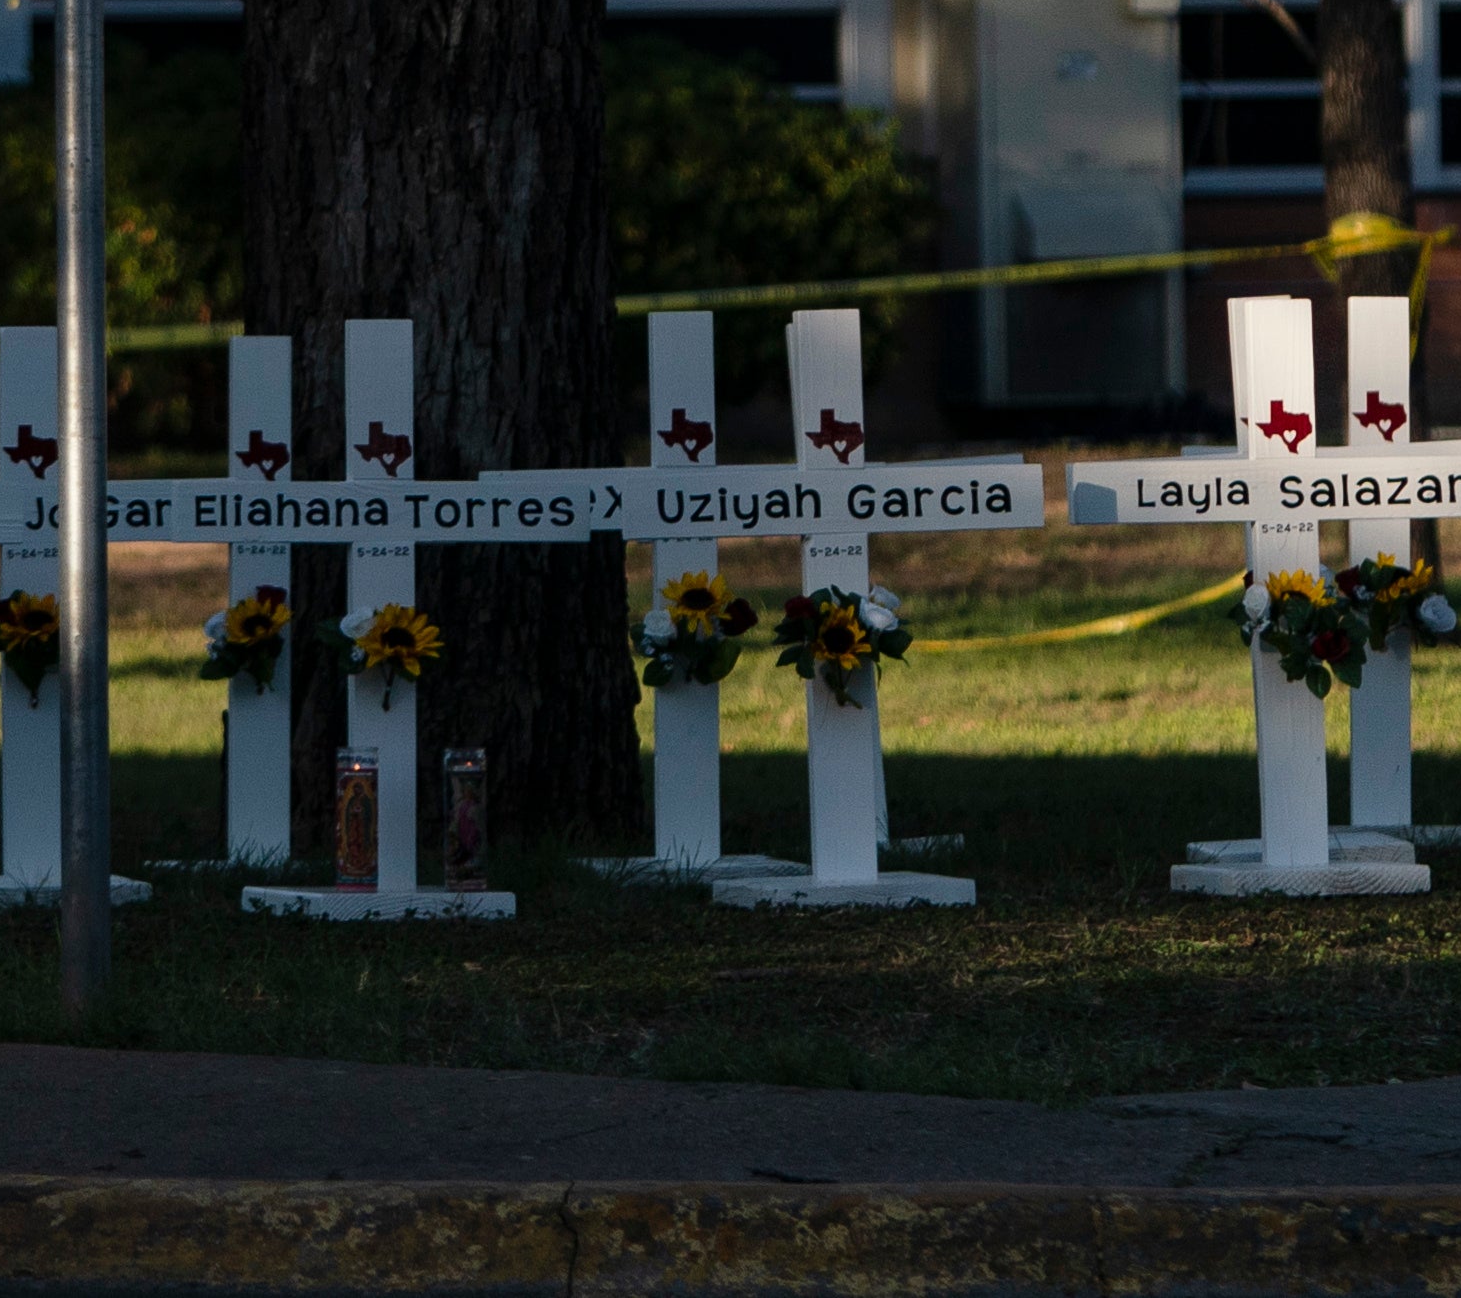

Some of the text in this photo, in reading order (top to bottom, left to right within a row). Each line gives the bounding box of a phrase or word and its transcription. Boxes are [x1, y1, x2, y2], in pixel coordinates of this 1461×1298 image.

[1137, 477, 1250, 515] Layla
[194, 493, 575, 529] Eliahana Torres
[656, 480, 1012, 530] Uziyah Garcia
[1261, 522, 1314, 534] 5-24-22
[6, 547, 59, 559] 5-24-22
[237, 545, 287, 555] 5-24-22
[357, 546, 410, 557] 5-24-22
[809, 545, 863, 558] 5-24-22
